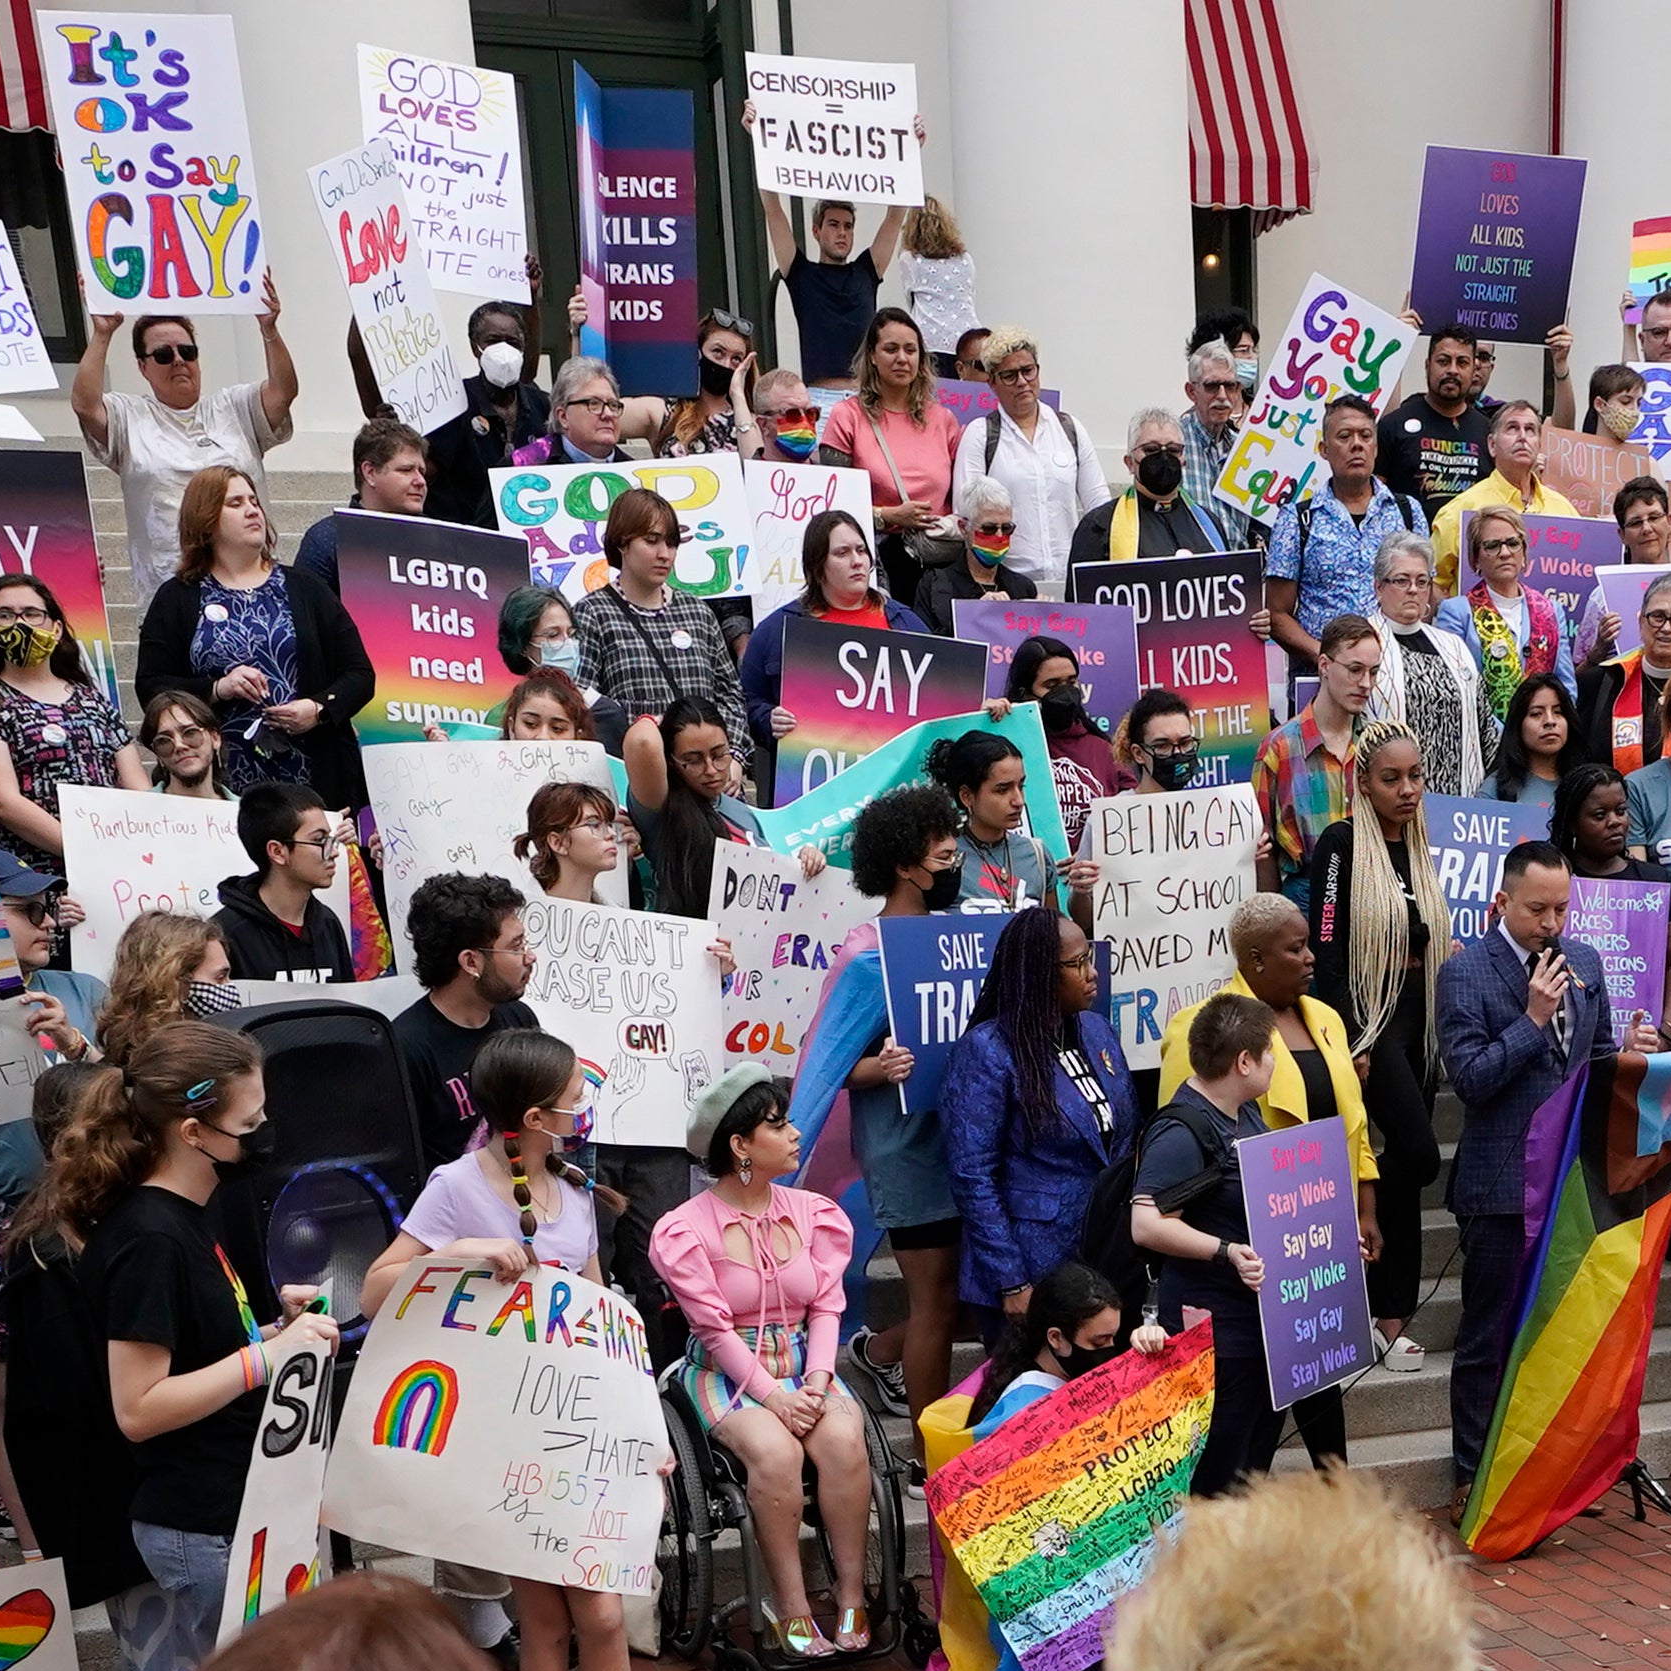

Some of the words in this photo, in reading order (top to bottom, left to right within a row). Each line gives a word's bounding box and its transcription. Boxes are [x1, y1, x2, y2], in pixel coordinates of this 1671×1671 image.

[56, 24, 190, 87] It's
[387, 57, 482, 108] GOD
[750, 70, 896, 101] CENSORSHIP
[74, 91, 193, 132] OK
[379, 93, 477, 132] LOVES
[379, 118, 492, 159] ALL
[760, 117, 909, 162] FASCIST
[81, 142, 136, 185] to
[145, 143, 240, 207] Say
[398, 172, 458, 197] NOT
[462, 186, 509, 210] just
[776, 166, 896, 195] BEHAVIOR
[1490, 162, 1518, 182] GOD
[424, 201, 458, 220] the
[1480, 193, 1520, 216] LOVES
[87, 191, 260, 300] GAY!
[338, 204, 408, 286] Love
[1470, 225, 1492, 245] ALL
[1455, 253, 1479, 273] NOT
[1480, 256, 1509, 275] JUST
[1512, 258, 1533, 278] THE
[373, 269, 406, 314] not
[609, 300, 664, 322] KIDS
[1456, 308, 1488, 330] WHITE
[1489, 311, 1519, 331] ONES
[1303, 290, 1402, 394] Gay
[1250, 394, 1317, 447] just
[1420, 436, 1480, 456] GUNCLE
[1544, 431, 1647, 487] PROTECT
[1545, 526, 1584, 551] Gay
[388, 555, 490, 601] LGBTQ
[1540, 556, 1594, 579] Woke
[1160, 573, 1247, 623] LOVES
[411, 603, 476, 638] kids
[1003, 611, 1043, 635] Say
[1047, 612, 1089, 637] Gay
[410, 655, 484, 685] need
[835, 640, 934, 717] SAY
[1171, 641, 1240, 689] KIDS,
[1214, 703, 1254, 737] THE
[1102, 800, 1199, 857] BEING
[1204, 796, 1256, 848] GAY
[1452, 811, 1511, 848] SAVE
[723, 865, 797, 914] DONT
[1097, 879, 1142, 922] AT
[1575, 881, 1645, 912] Welcome
[576, 910, 690, 971] CAN'T
[1569, 910, 1614, 932] RACES
[938, 932, 987, 971] SAVE
[1103, 933, 1193, 977] SAVED
[621, 969, 678, 1019] US
[624, 1022, 668, 1055] GAY!
[1272, 1146, 1295, 1175] Say
[1297, 1139, 1323, 1166] Gay
[1268, 1186, 1299, 1219] Stay
[1299, 1176, 1337, 1206] Woke
[1282, 1230, 1307, 1260] Say
[1308, 1221, 1333, 1251] Gay
[1279, 1274, 1309, 1310] Stay
[1309, 1259, 1347, 1293] Woke
[395, 1266, 574, 1348] FEAR
[1294, 1315, 1318, 1344] Say
[1318, 1304, 1344, 1336] Gay
[1291, 1359, 1321, 1390] Stay
[1320, 1341, 1357, 1374] Woke
[585, 1427, 655, 1478] HATE
[1082, 1415, 1175, 1482] PROTECT
[529, 1525, 569, 1553] the
[586, 1510, 629, 1541] NOT
